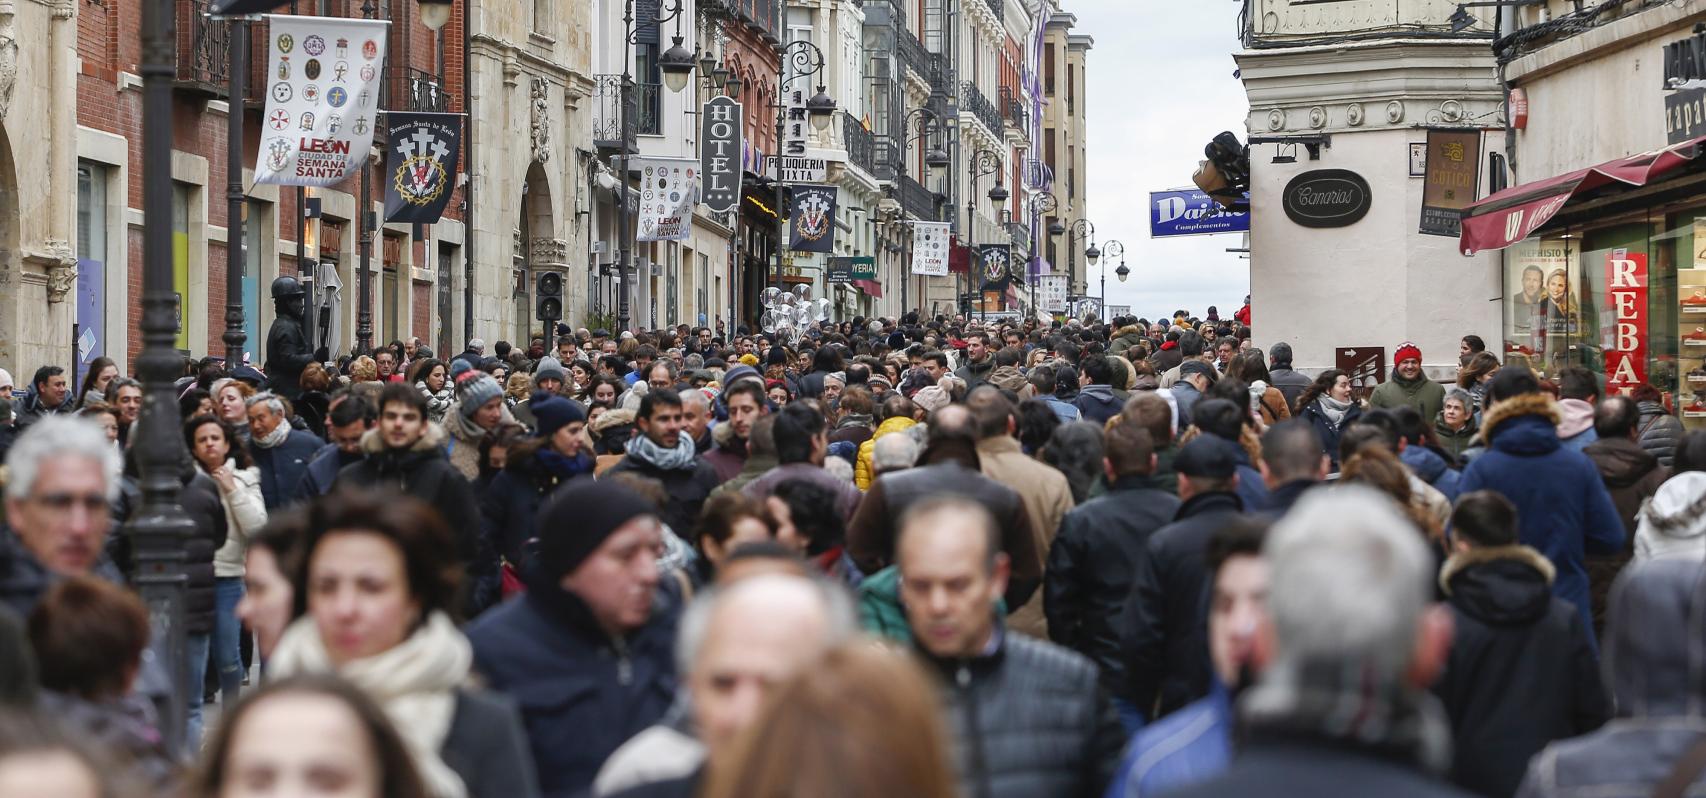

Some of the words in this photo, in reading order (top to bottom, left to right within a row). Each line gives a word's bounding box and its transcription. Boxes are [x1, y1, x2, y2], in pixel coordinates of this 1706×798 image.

[788, 91, 806, 154] IRIS
[390, 124, 412, 136] Semana
[441, 125, 455, 137] León
[709, 105, 733, 191] HOTEL
[298, 152, 333, 160] CIUDAD
[297, 159, 346, 168] SEMANA
[769, 158, 825, 170] PUQUERIA
[296, 167, 344, 178] SANTA
[1298, 187, 1352, 206] Canarias
[1175, 222, 1231, 231] Complementos
[1520, 248, 1561, 258] MEPHISTO
